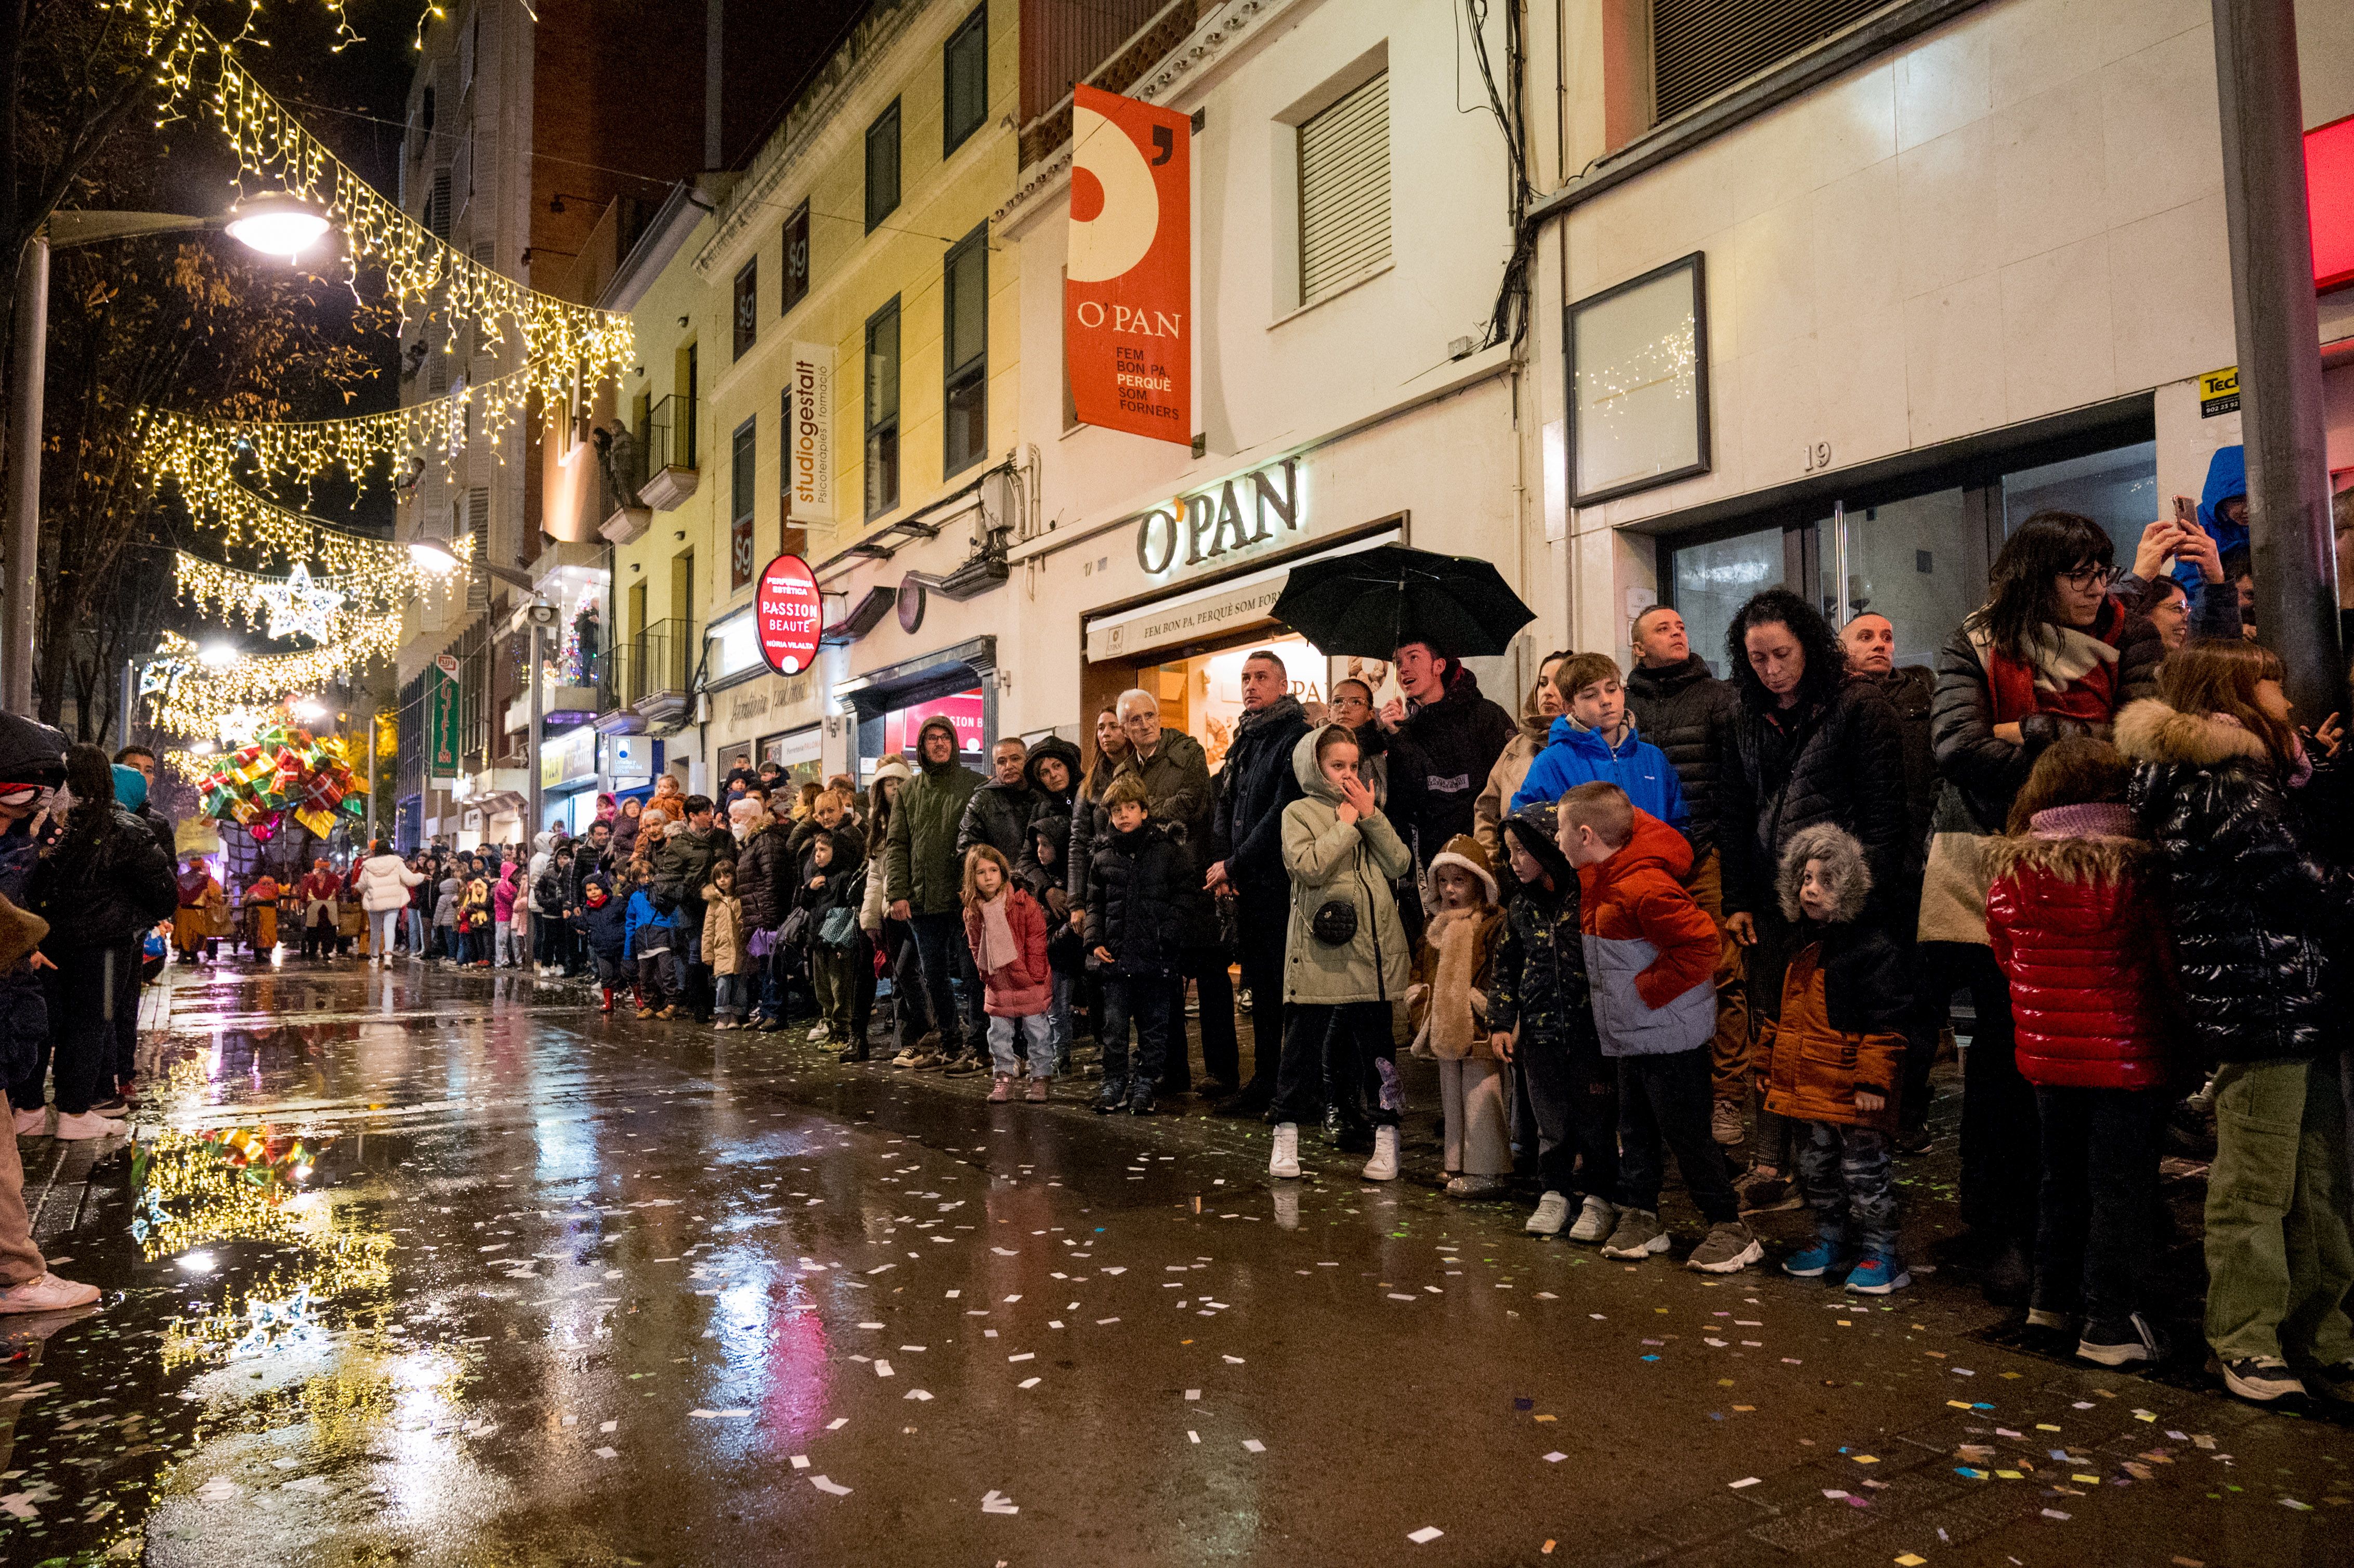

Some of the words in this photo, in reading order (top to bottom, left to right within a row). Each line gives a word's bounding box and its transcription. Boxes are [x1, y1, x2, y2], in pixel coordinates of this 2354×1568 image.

[1077, 300, 1182, 339] O'PAN
[1117, 347, 1144, 360] FEM
[1117, 361, 1145, 374] BON
[1150, 364, 1170, 379] PA,
[818, 366, 828, 418] formació
[1117, 373, 1171, 391] PERQUÈ
[1119, 387, 1147, 401] SOM
[1120, 400, 1179, 420] FORNERS
[796, 360, 819, 503] studiogestalt
[818, 428, 828, 503] Psicoteràpies
[1803, 441, 1831, 472] 19
[1137, 455, 1301, 574] O'PAN
[762, 600, 817, 618] PASSION
[1144, 625, 1161, 638] FEM
[1163, 619, 1181, 634] BON
[1183, 617, 1195, 628] PA,
[1197, 603, 1234, 624] PERQUÈ
[1235, 598, 1256, 615] SOM
[787, 642, 814, 650] VILALTA
[1291, 680, 1327, 702] PA
[950, 716, 974, 728] SION
